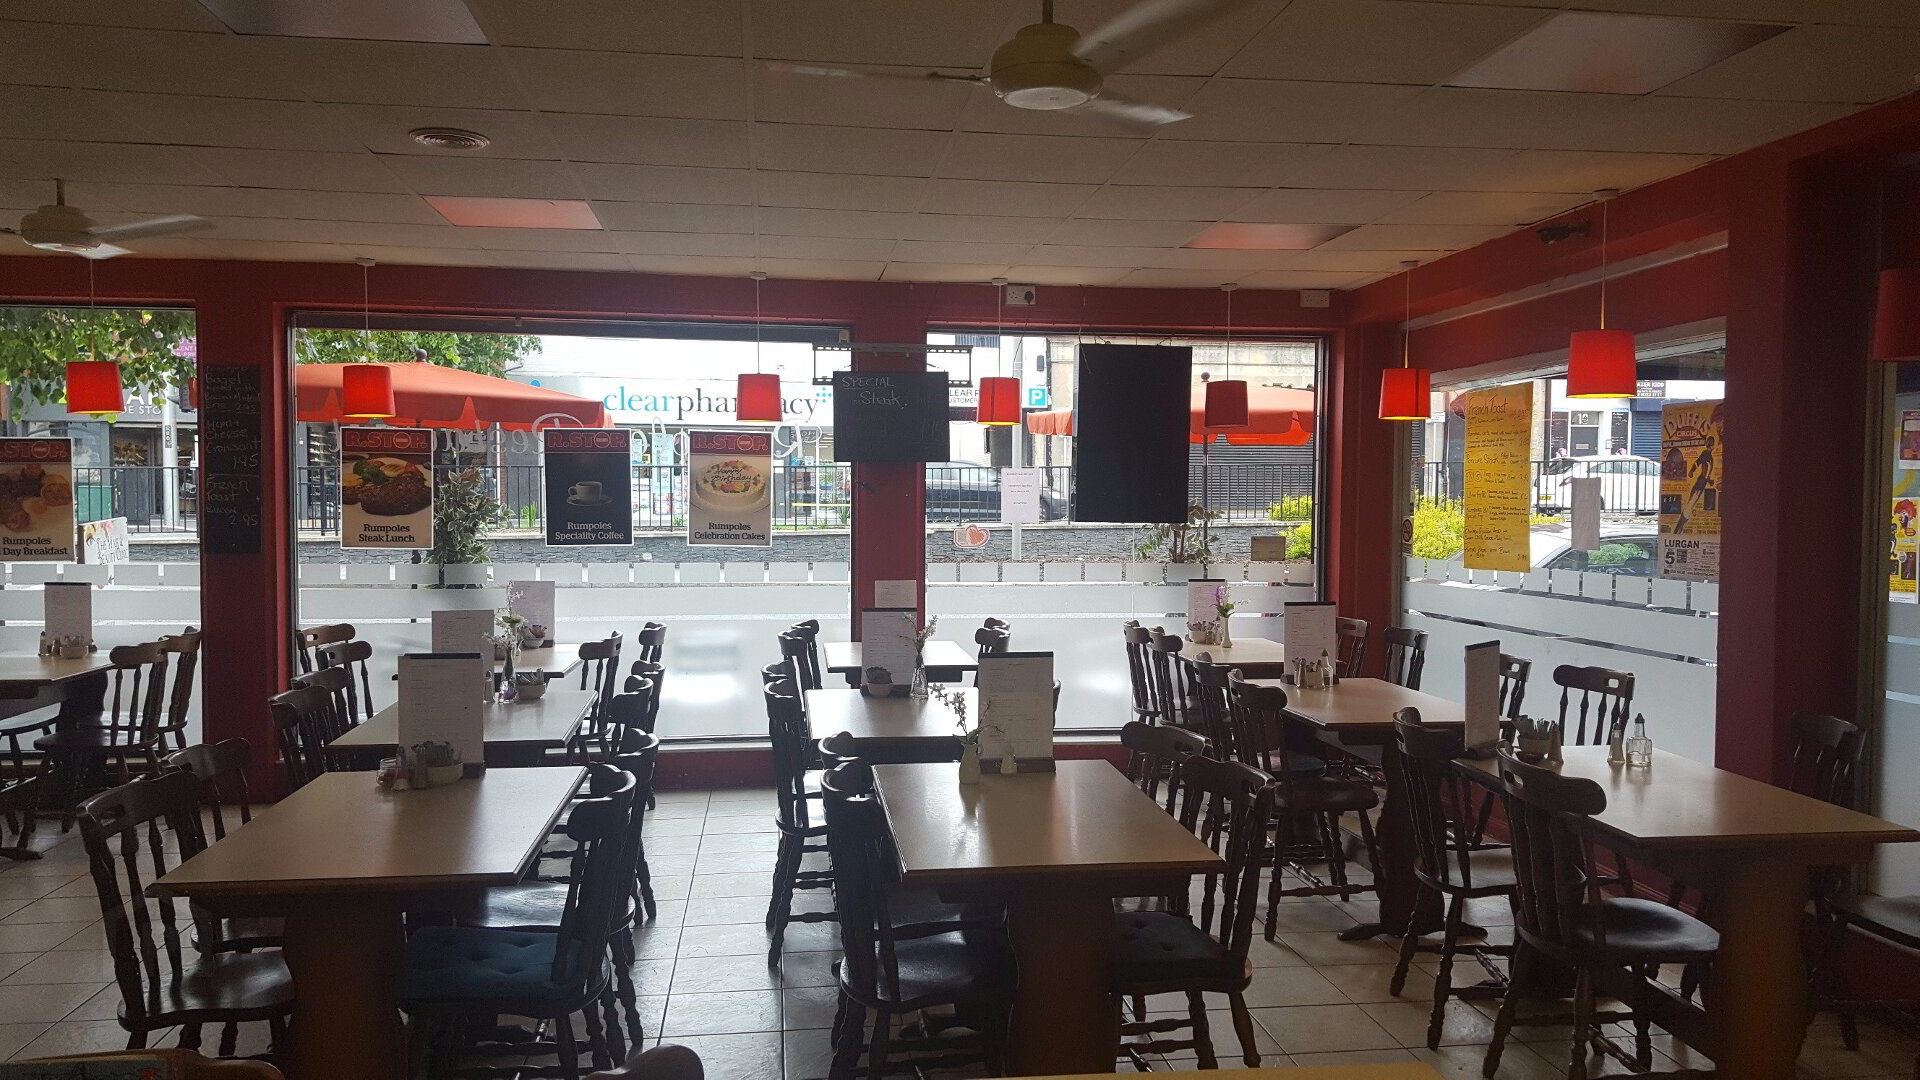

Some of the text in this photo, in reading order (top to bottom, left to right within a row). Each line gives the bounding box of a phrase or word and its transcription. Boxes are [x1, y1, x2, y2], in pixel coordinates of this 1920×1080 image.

[841, 376, 896, 389] SPECIAL
[948, 389, 974, 398] LEAR
[1030, 389, 1044, 406] P
[138, 405, 162, 415] STO
[711, 464, 743, 476] Happy
[711, 472, 752, 484] Birthday
[364, 523, 411, 534] Rumpoles
[567, 521, 613, 532] Rumpoles
[708, 522, 752, 532] Rumpoles
[3, 537, 52, 547] Rumpoles
[358, 534, 416, 543] Steak Lunch
[555, 531, 625, 542] Speciality Coffee
[694, 532, 766, 541] Celebration Cakes
[1664, 538, 1700, 549] LURGAN
[3, 547, 68, 557] Day Breakfast
[1664, 551, 1676, 565] 5
